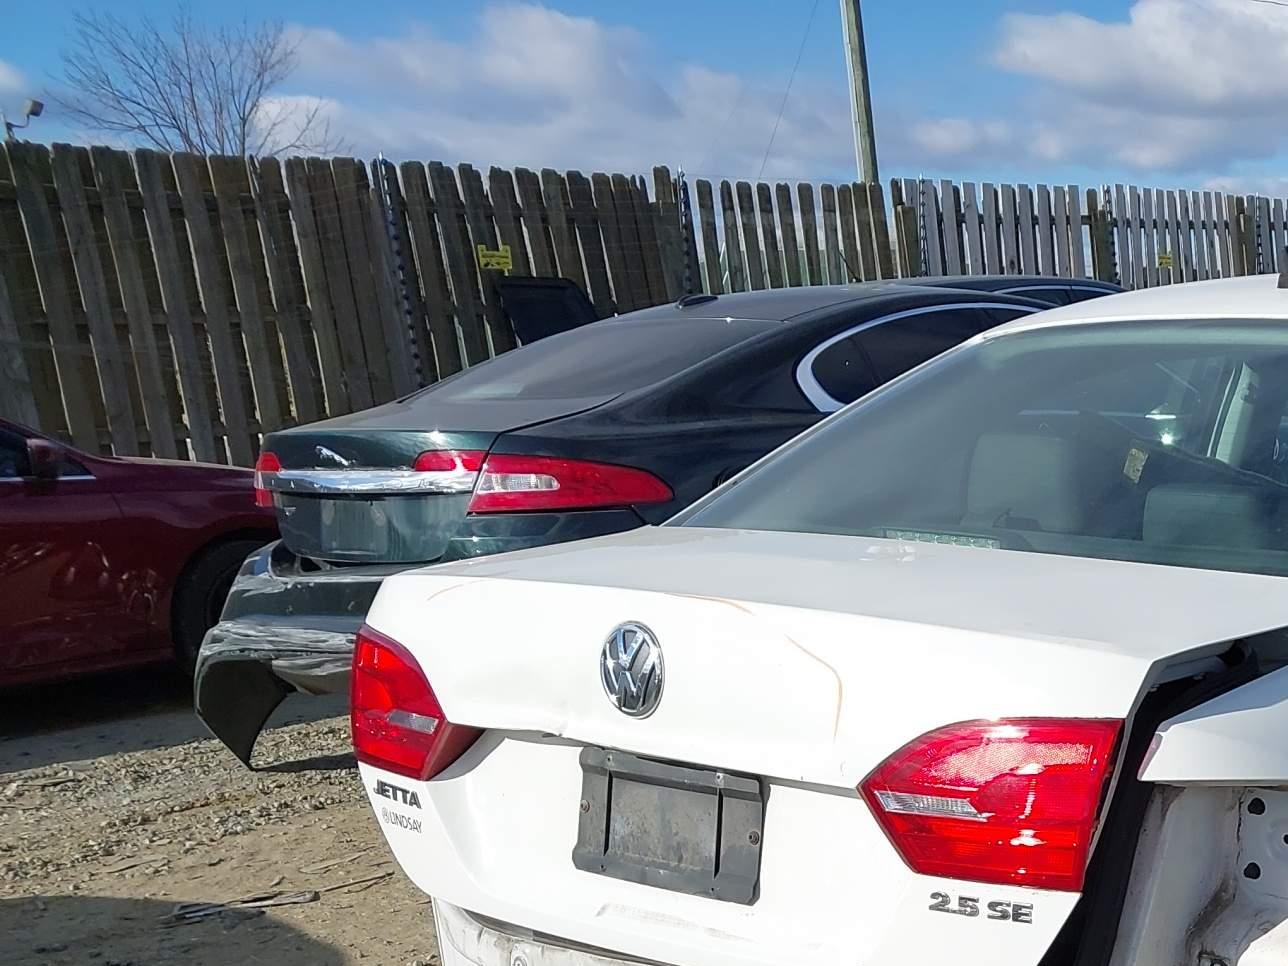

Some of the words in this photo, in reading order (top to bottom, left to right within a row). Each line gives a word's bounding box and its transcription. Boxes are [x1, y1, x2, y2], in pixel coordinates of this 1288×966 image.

[373, 779, 421, 809] JETTA
[389, 811, 422, 833] LINDSAY
[928, 892, 979, 917] 2.5
[987, 901, 1033, 924] SE
